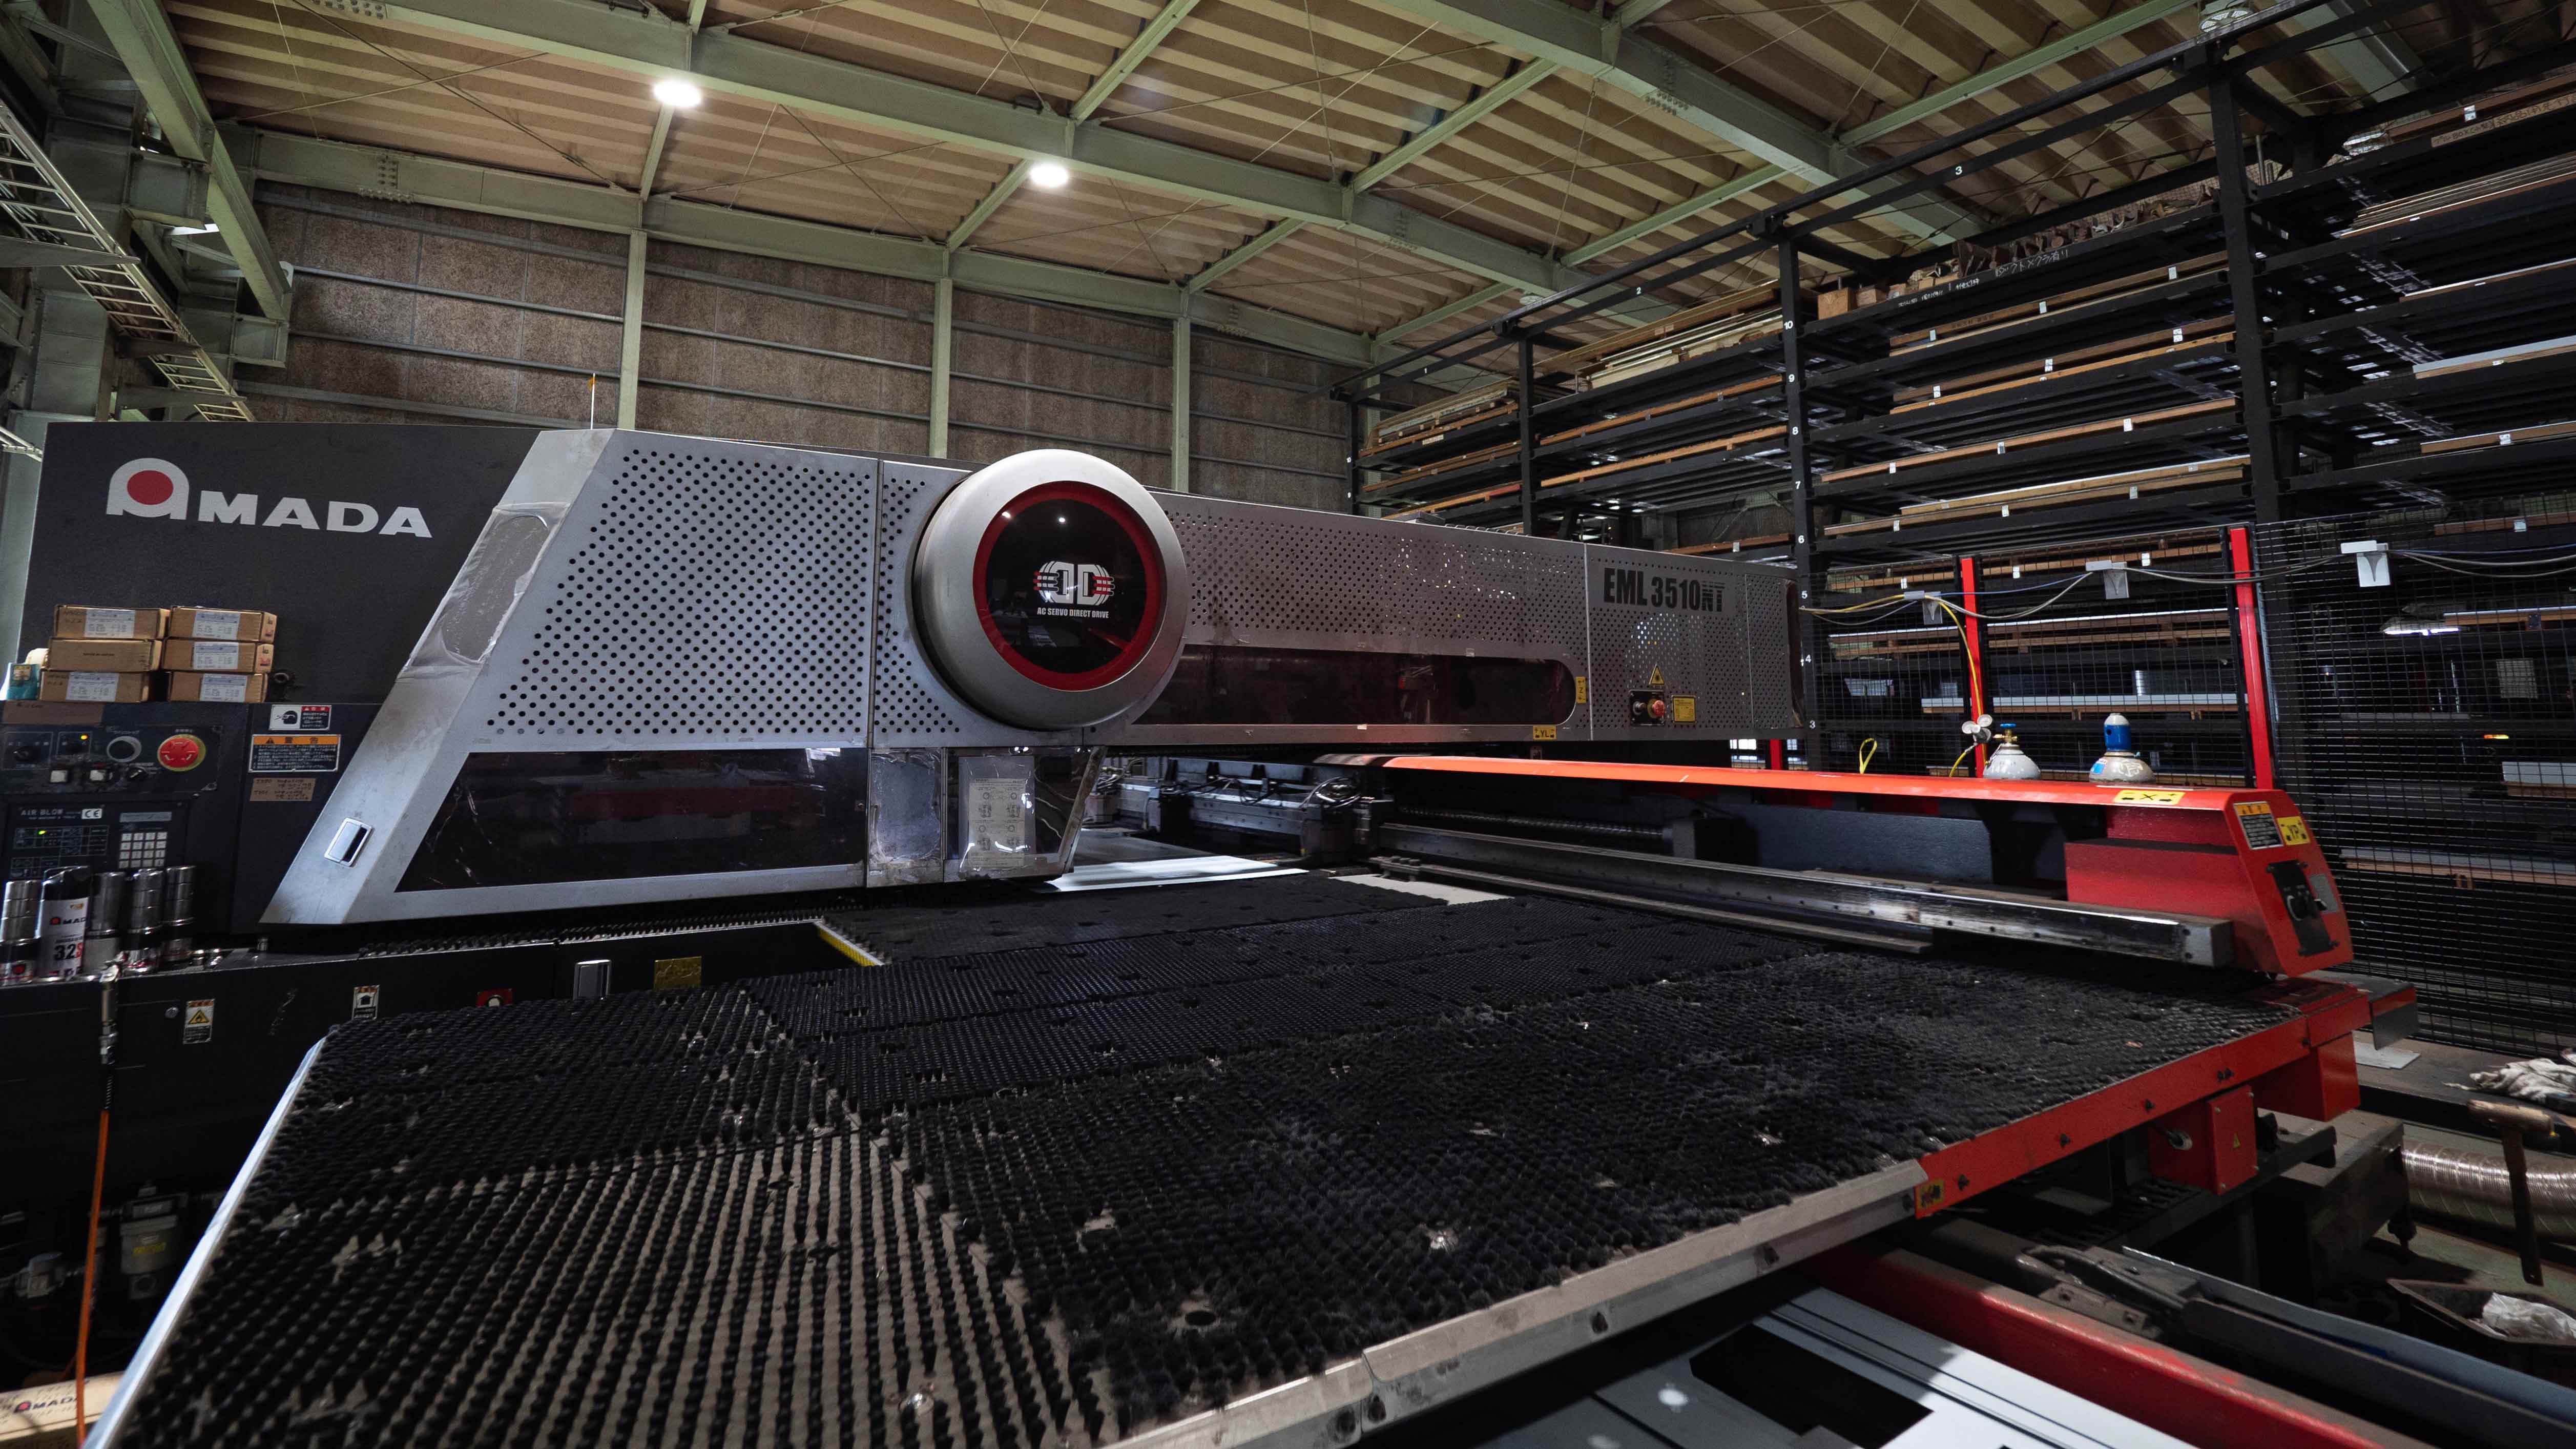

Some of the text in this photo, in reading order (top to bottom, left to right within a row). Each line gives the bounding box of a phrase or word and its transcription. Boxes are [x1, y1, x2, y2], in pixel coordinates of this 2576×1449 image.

[1955, 165, 1963, 175] 3
[1784, 320, 1793, 329] 10
[1789, 374, 1795, 382] 9
[1792, 426, 1799, 435] 8
[1795, 481, 1801, 489] 7
[106, 458, 432, 538] AMADA
[1798, 535, 1804, 544] 6
[1604, 567, 1648, 606] EML
[1801, 591, 1808, 599] 5
[1036, 607, 1109, 619] AC SERVO DIRECT DRIVE
[1805, 654, 1812, 663] 4
[1810, 720, 1816, 729] 3
[1540, 729, 1550, 738] YL
[2142, 793, 2158, 801] X
[85, 809, 100, 818] CE
